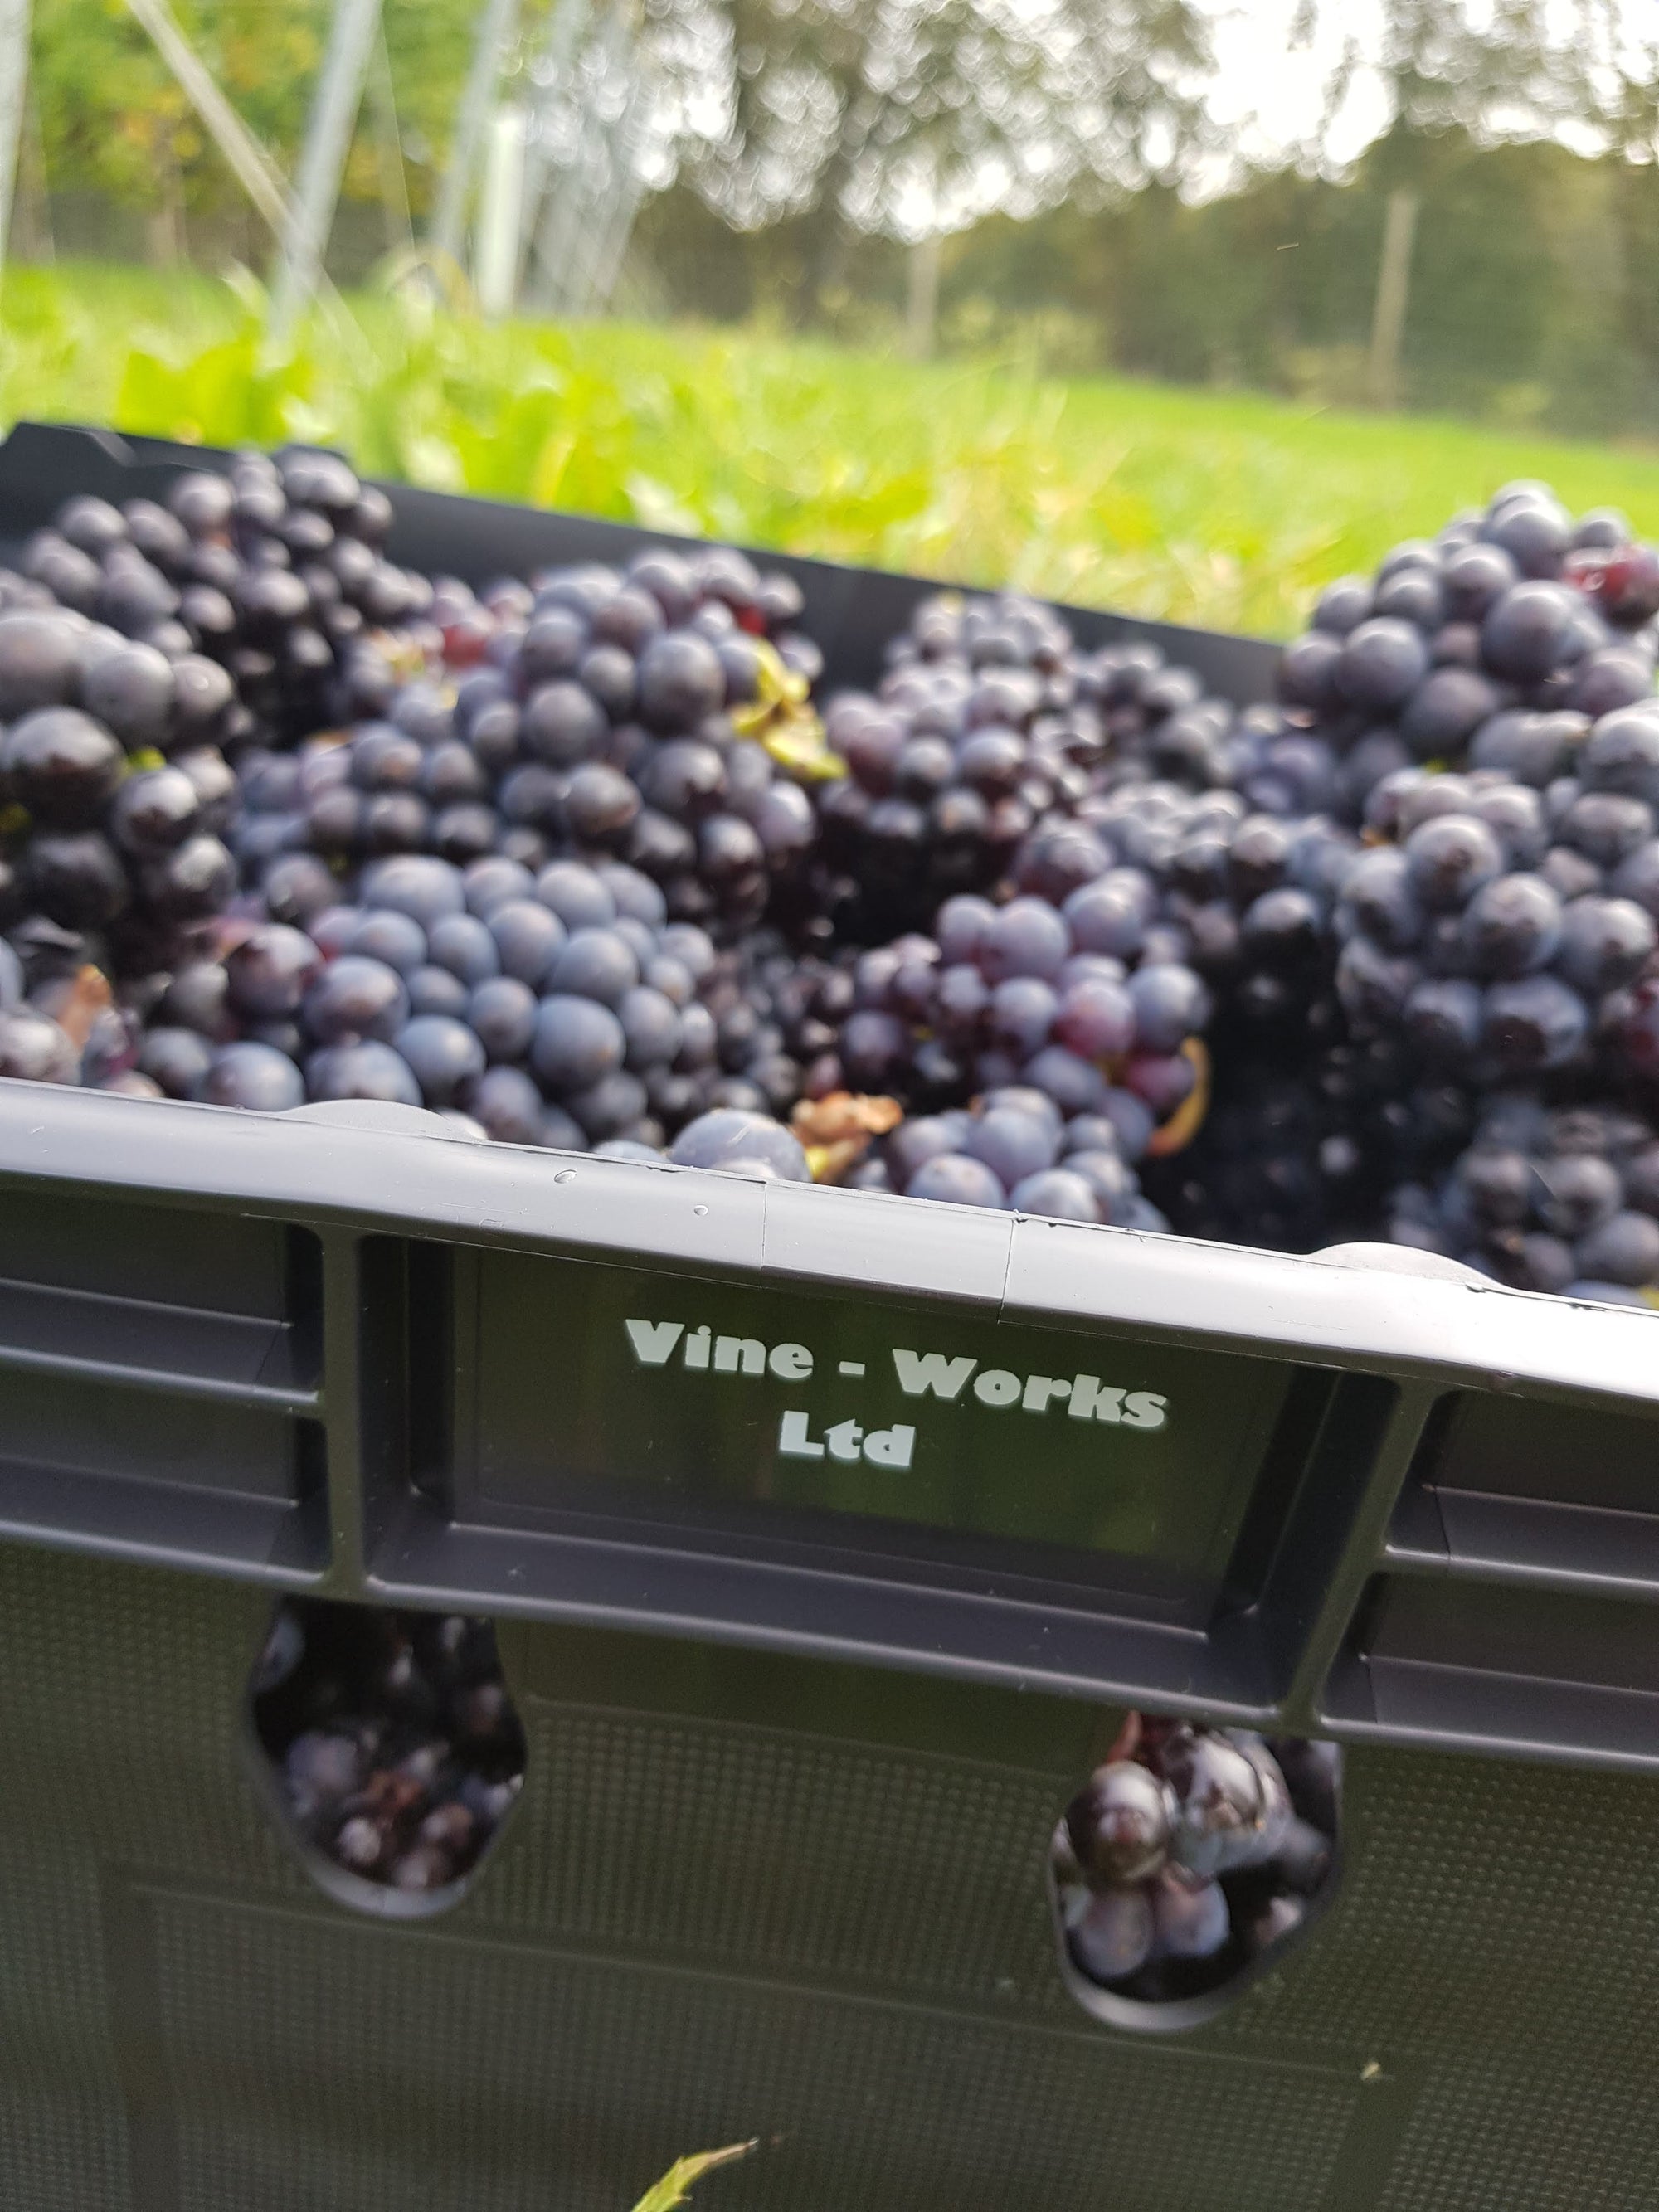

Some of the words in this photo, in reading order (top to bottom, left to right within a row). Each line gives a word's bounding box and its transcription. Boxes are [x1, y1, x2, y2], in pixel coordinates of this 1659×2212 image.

[625, 1319, 814, 1379] Vine
[839, 1361, 865, 1375] -
[892, 1349, 1168, 1428] Works
[779, 1410, 916, 1467] Ltd
